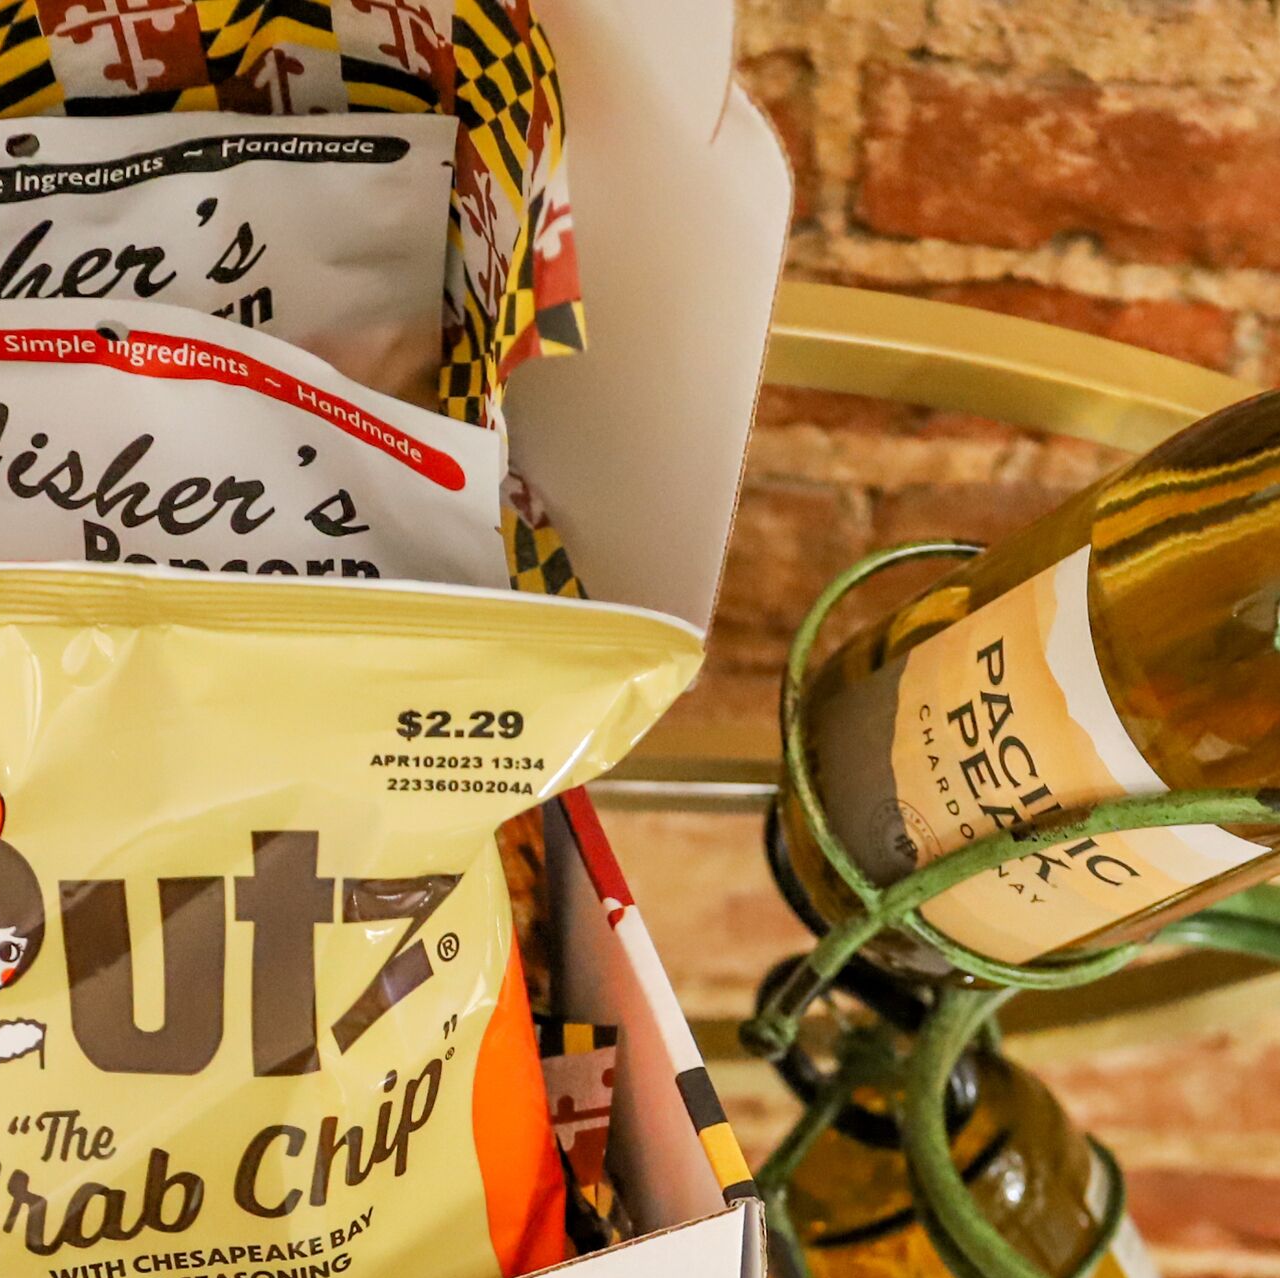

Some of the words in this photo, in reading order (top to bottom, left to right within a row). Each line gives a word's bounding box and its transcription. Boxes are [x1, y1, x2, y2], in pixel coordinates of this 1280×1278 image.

[14, 156, 164, 192] Ingredients
[221, 138, 374, 157] Handmade
[3, 335, 96, 359] Simple
[108, 339, 249, 376] Ingredients
[296, 384, 423, 463] Handmade
[396, 709, 524, 741] $2.29
[370, 754, 483, 769] APR102023
[491, 757, 545, 772] 13:34
[387, 778, 533, 795] 22336030204A
[977, 636, 1140, 887] PACIIC
[133, 1236, 323, 1275] CHESAPEAKE
[330, 1206, 376, 1248] BAY
